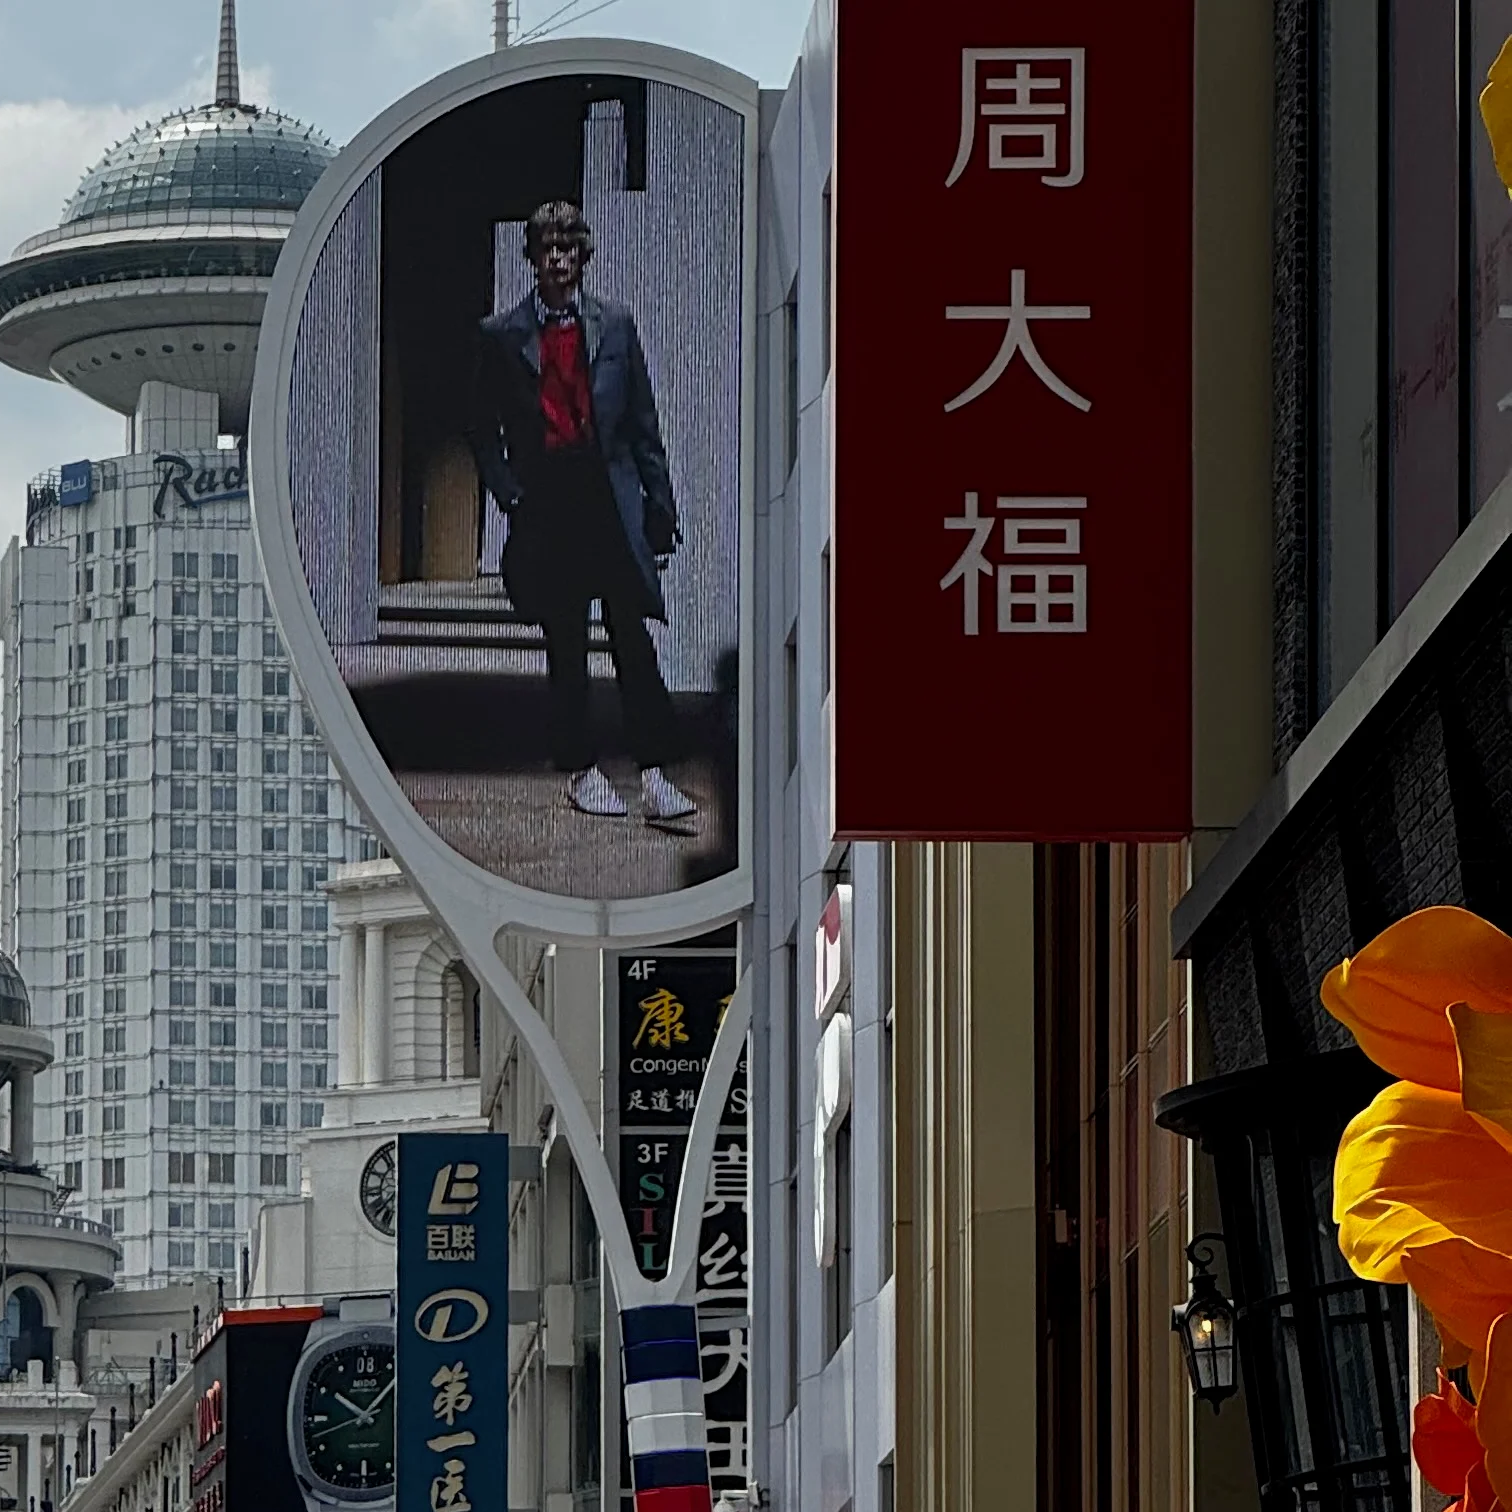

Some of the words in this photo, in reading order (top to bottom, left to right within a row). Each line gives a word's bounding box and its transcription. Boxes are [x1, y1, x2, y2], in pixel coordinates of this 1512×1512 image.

[939, 47, 1092, 636] 周大福
[627, 960, 657, 981] 4F
[637, 1144, 669, 1163] 3F
[426, 1224, 475, 1250] 百联
[356, 1356, 375, 1374] 08
